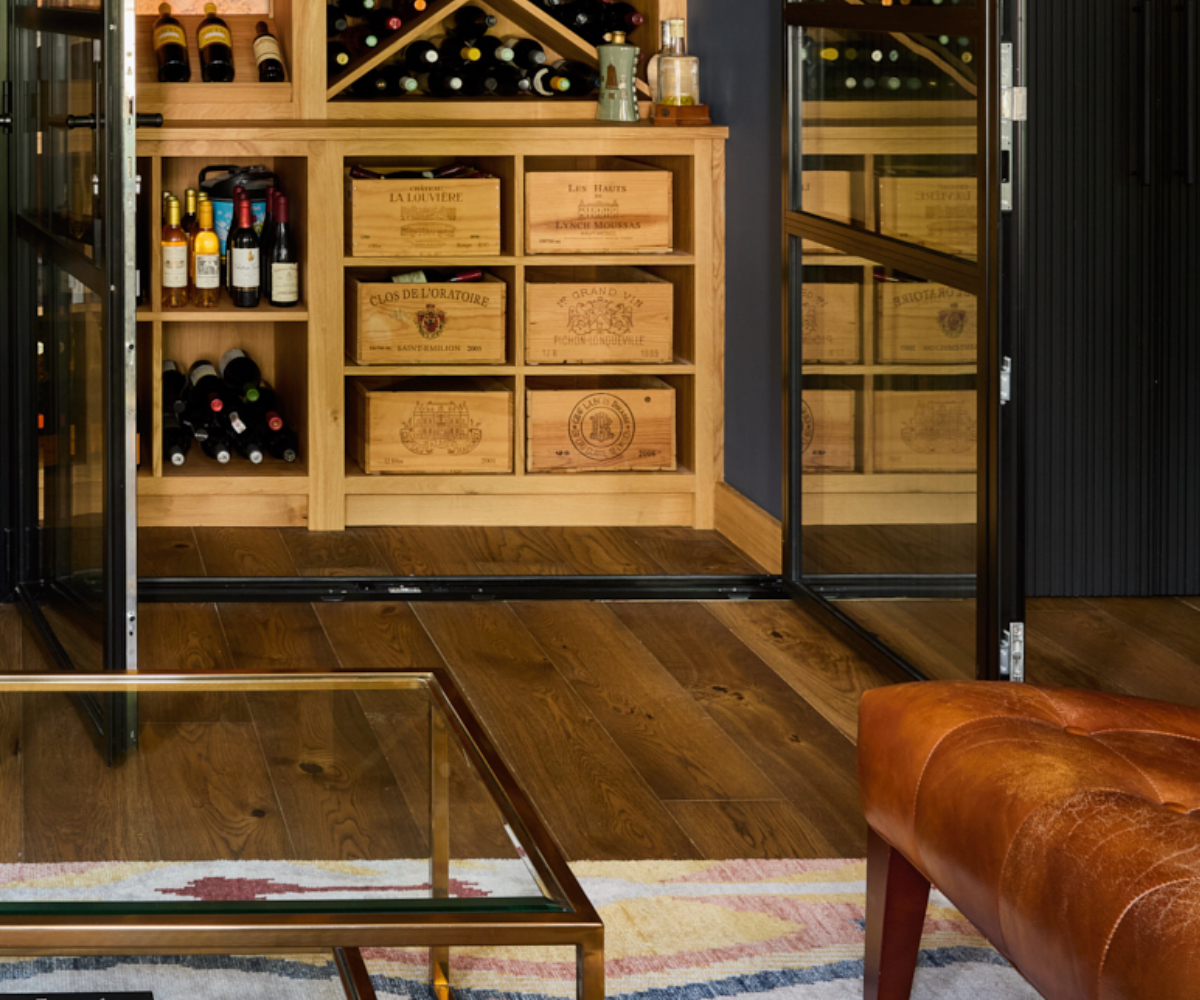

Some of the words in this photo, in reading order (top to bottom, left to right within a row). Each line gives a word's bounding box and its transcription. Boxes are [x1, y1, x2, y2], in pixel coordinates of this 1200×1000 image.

[568, 184, 587, 192] LES
[594, 184, 627, 192] HAUTS
[390, 193, 404, 203] LA
[407, 192, 463, 203] LOUVIÈRE
[555, 221, 590, 229] LYNCH
[594, 221, 642, 229] MOUSSAS
[369, 291, 400, 307] CLOS
[402, 288, 419, 300] DE
[421, 288, 490, 308] L'ORATOIRE
[572, 287, 617, 300] GRAND
[623, 291, 644, 308] VIN
